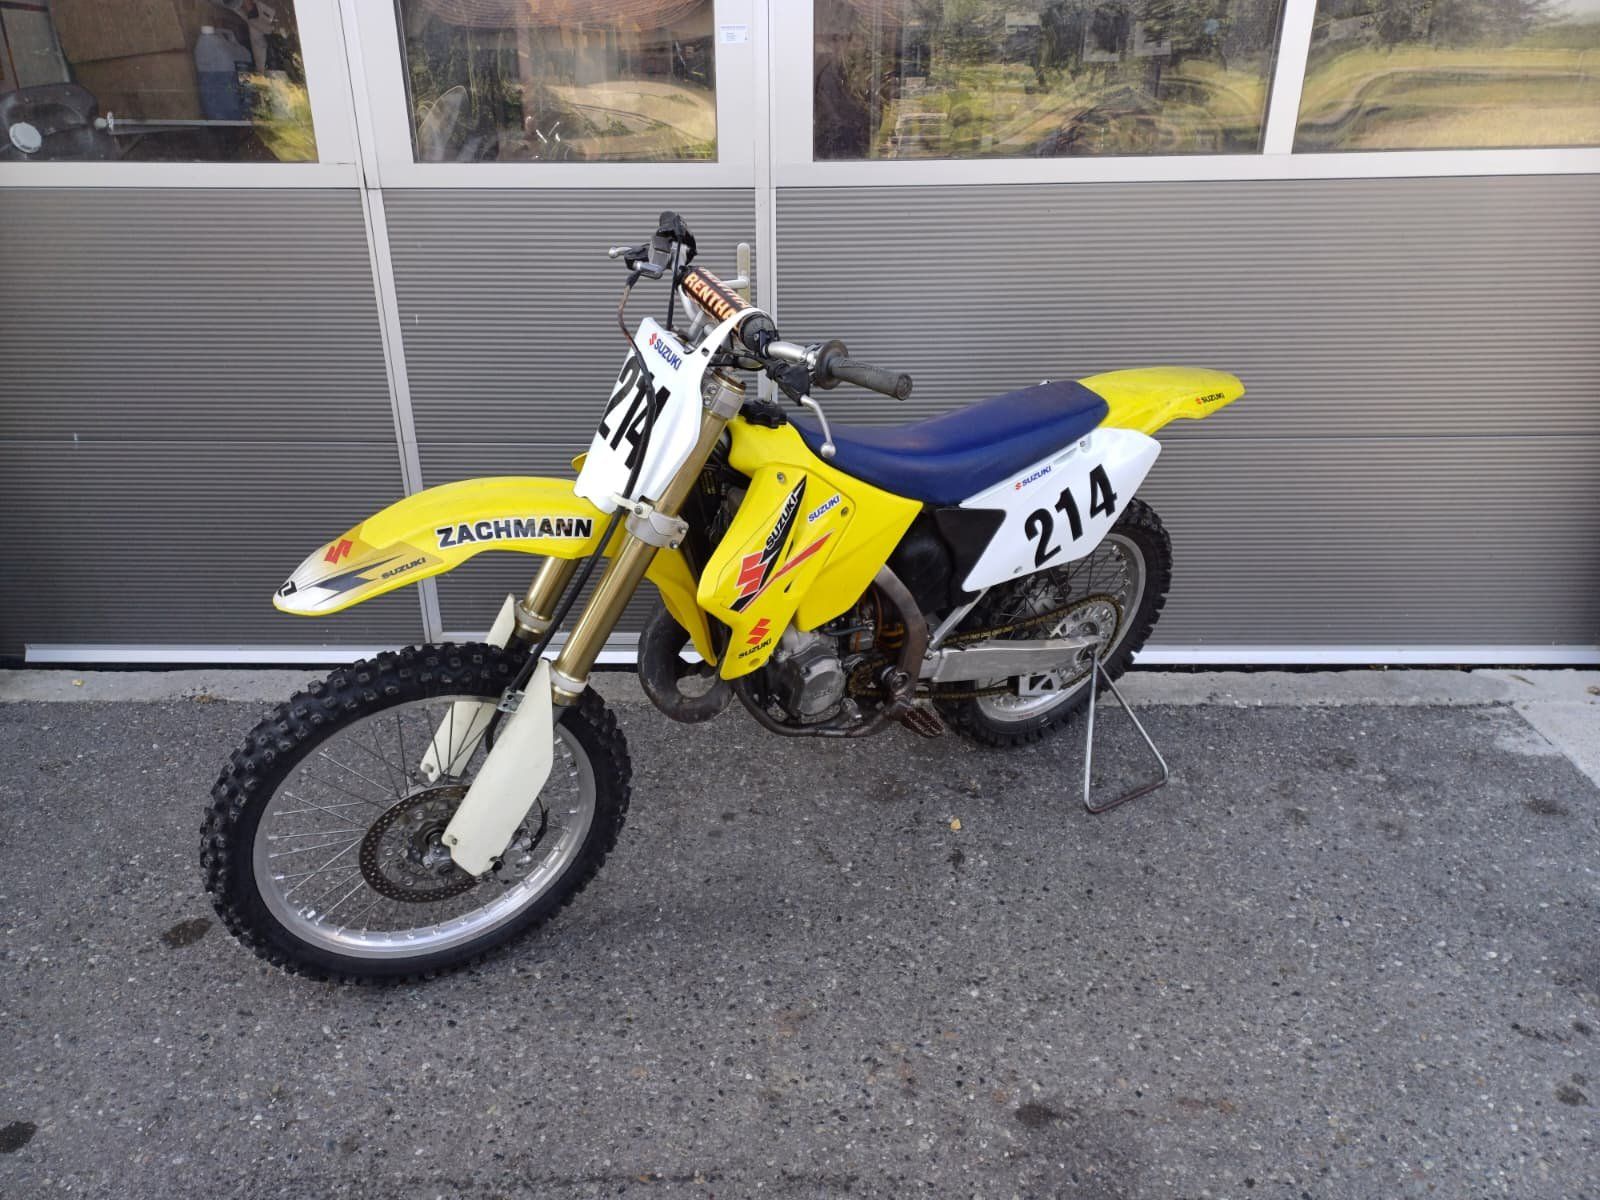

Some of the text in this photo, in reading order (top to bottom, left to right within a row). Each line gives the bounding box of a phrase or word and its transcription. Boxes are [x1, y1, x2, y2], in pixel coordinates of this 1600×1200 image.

[684, 271, 738, 321] RENTHA
[653, 339, 682, 370] SUZUKI
[1200, 392, 1225, 403] SUZUKI
[1022, 465, 1052, 486] SUZUKI
[766, 494, 797, 550] SUZUKI
[808, 494, 840, 522] SUZUKI
[1024, 463, 1117, 568] 214
[437, 519, 592, 547] ZACHMANN
[382, 557, 426, 579] SUZUKI
[738, 638, 771, 659] SUZUKI
